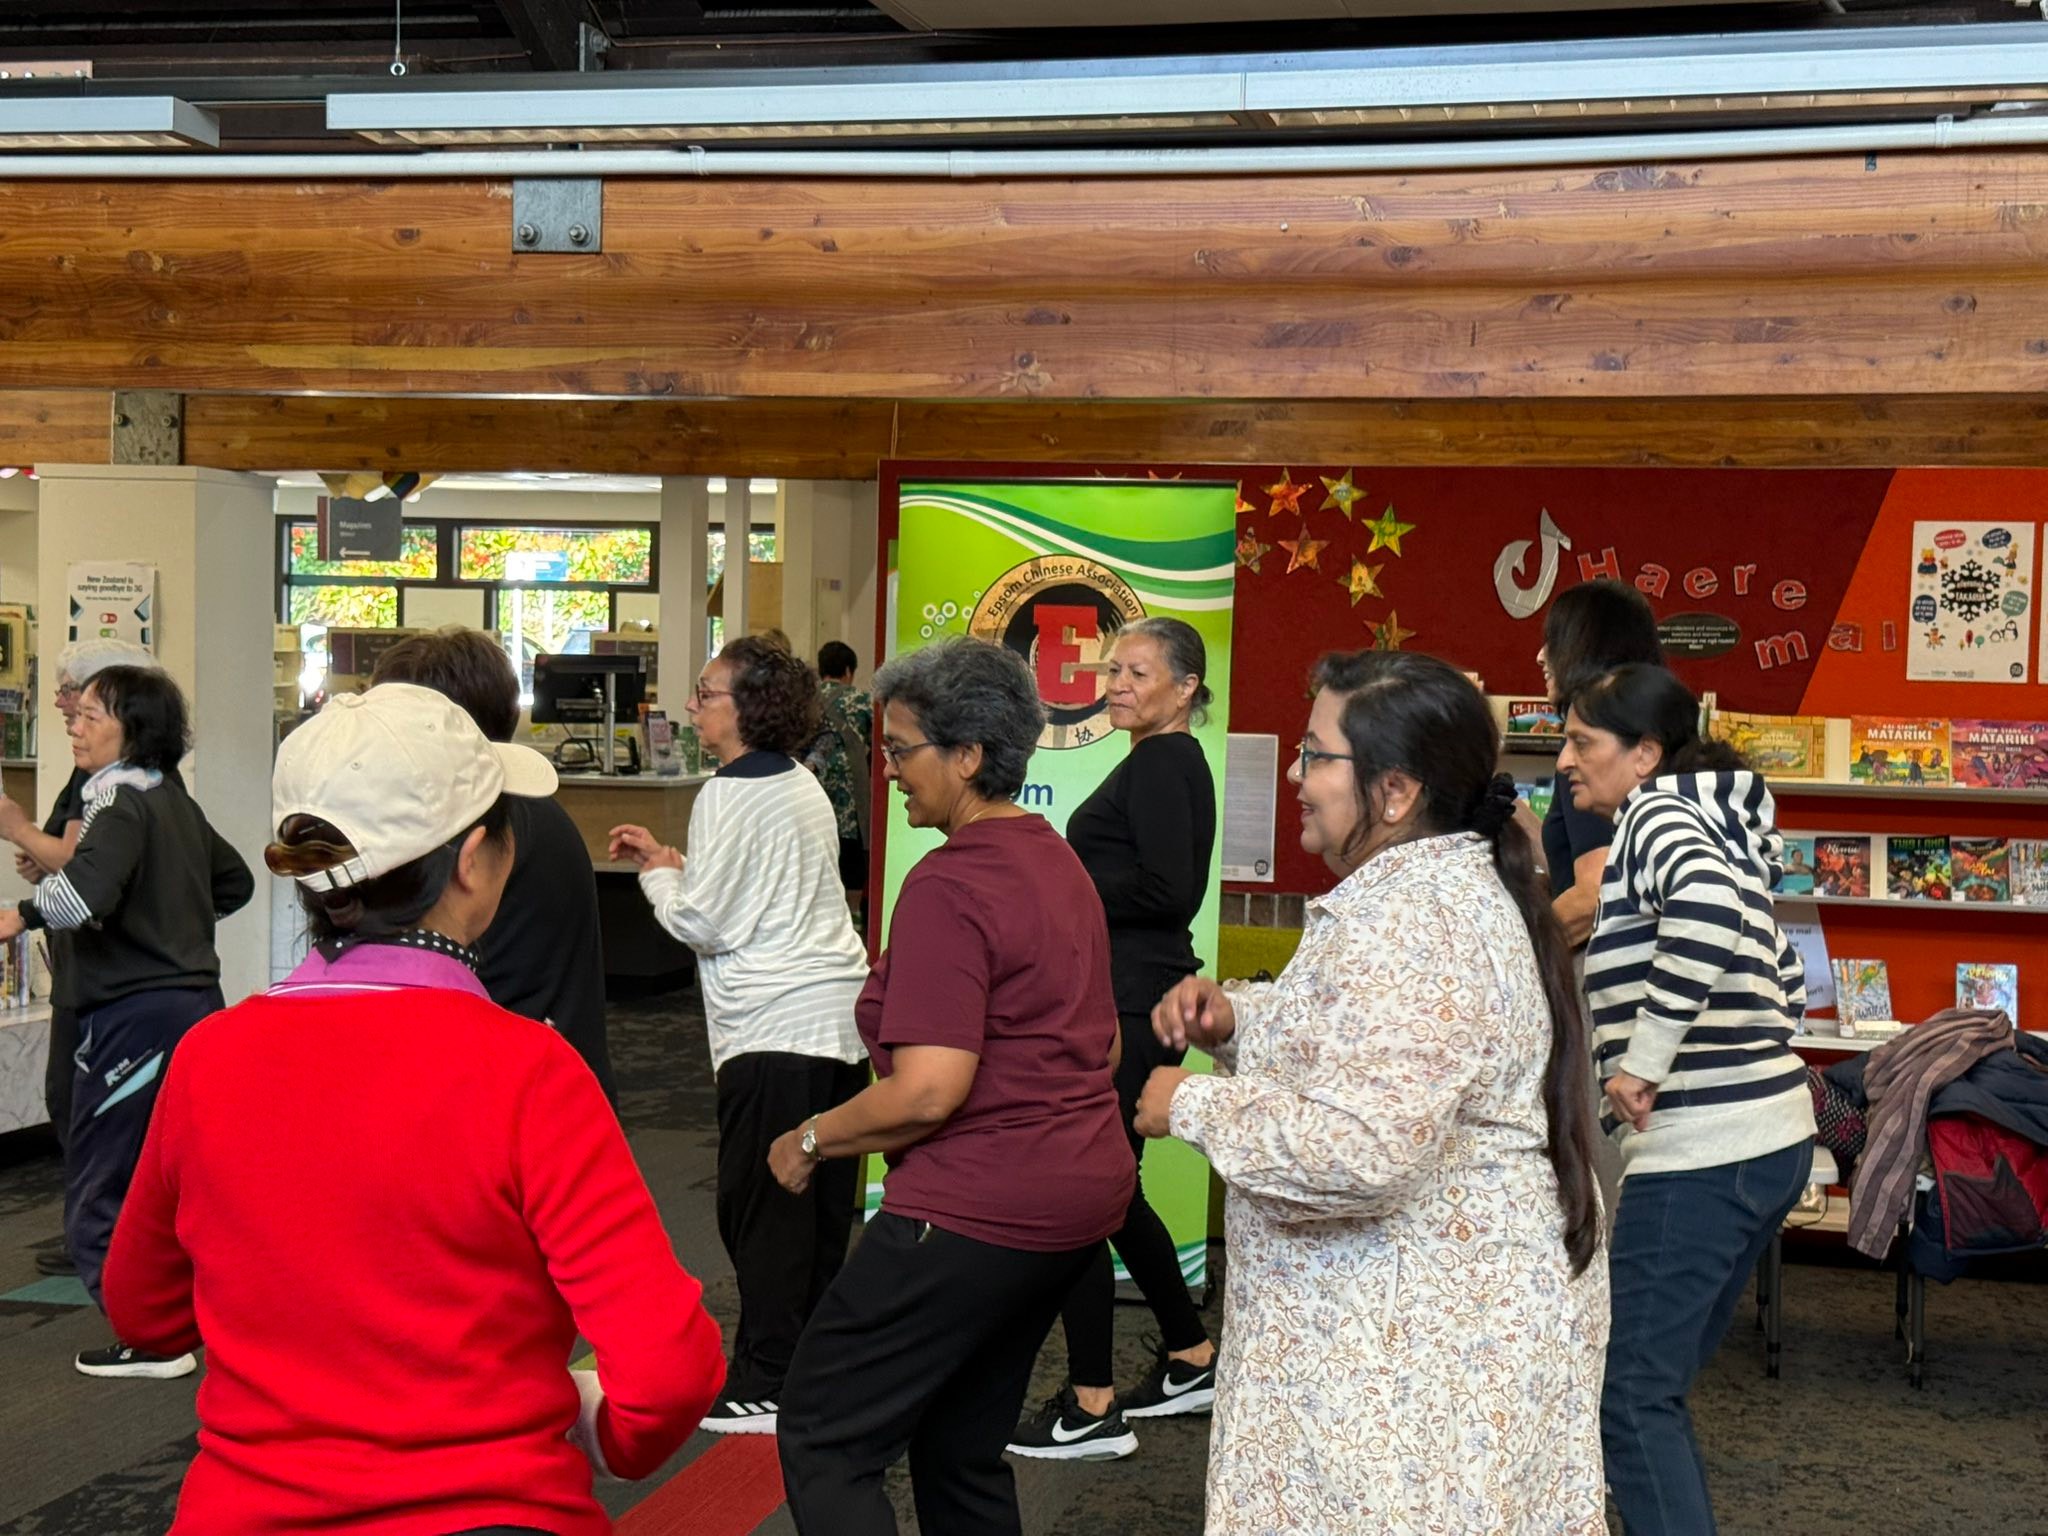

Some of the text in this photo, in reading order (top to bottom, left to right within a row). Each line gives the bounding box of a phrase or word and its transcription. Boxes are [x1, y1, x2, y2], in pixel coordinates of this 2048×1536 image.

[987, 564, 1139, 618] Epsom Chinese Association
[1867, 728, 1932, 740] MATARIKI
[1968, 732, 2035, 745] MATARIKI
